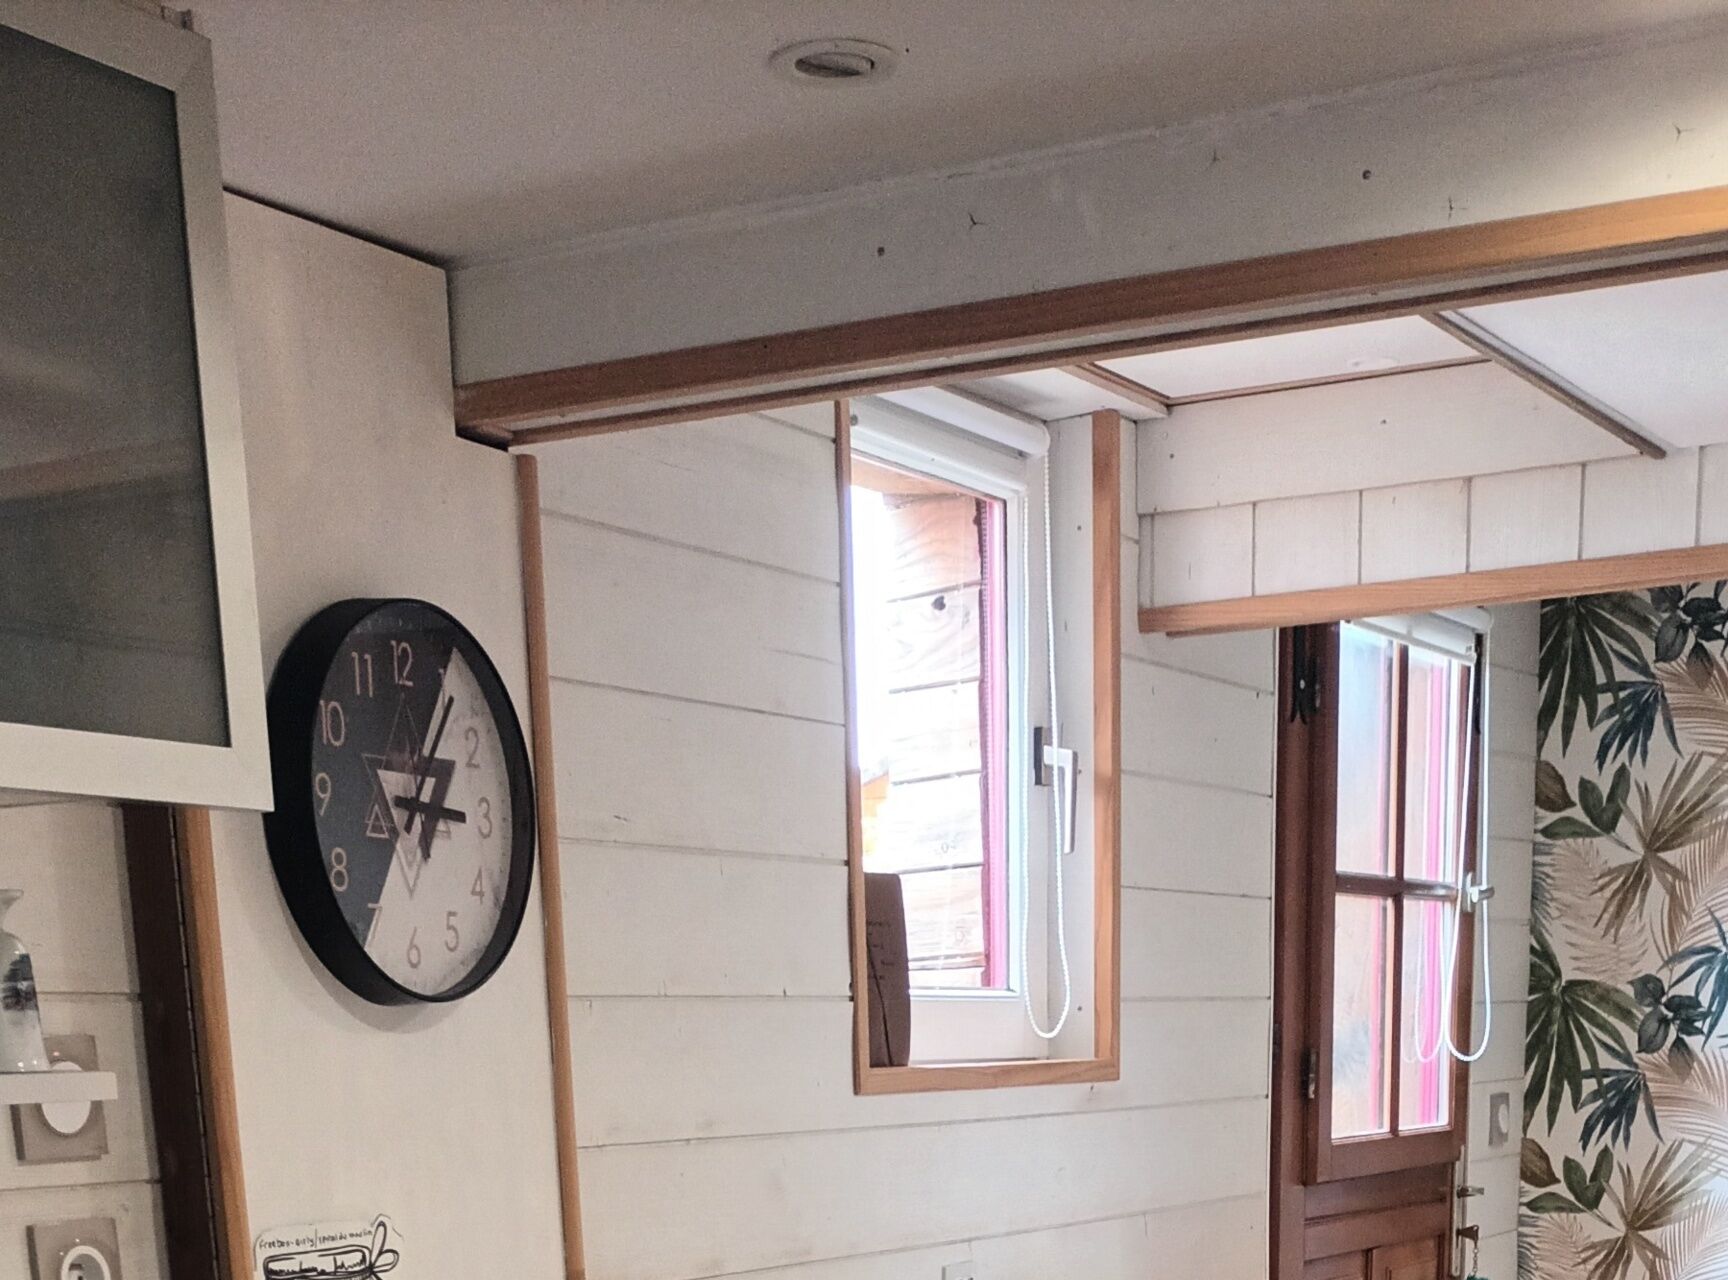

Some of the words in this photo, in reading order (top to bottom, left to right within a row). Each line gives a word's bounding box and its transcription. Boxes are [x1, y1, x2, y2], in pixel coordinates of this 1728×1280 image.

[351, 651, 375, 698] 11
[390, 640, 414, 687] 12
[319, 699, 346, 747] 10
[464, 727, 481, 769] 2
[315, 772, 332, 816] 9
[477, 797, 493, 839] 3
[330, 847, 349, 892] 8
[470, 867, 486, 903] 4
[367, 902, 383, 947] 7
[445, 911, 460, 952] 5
[406, 926, 422, 969] 6
